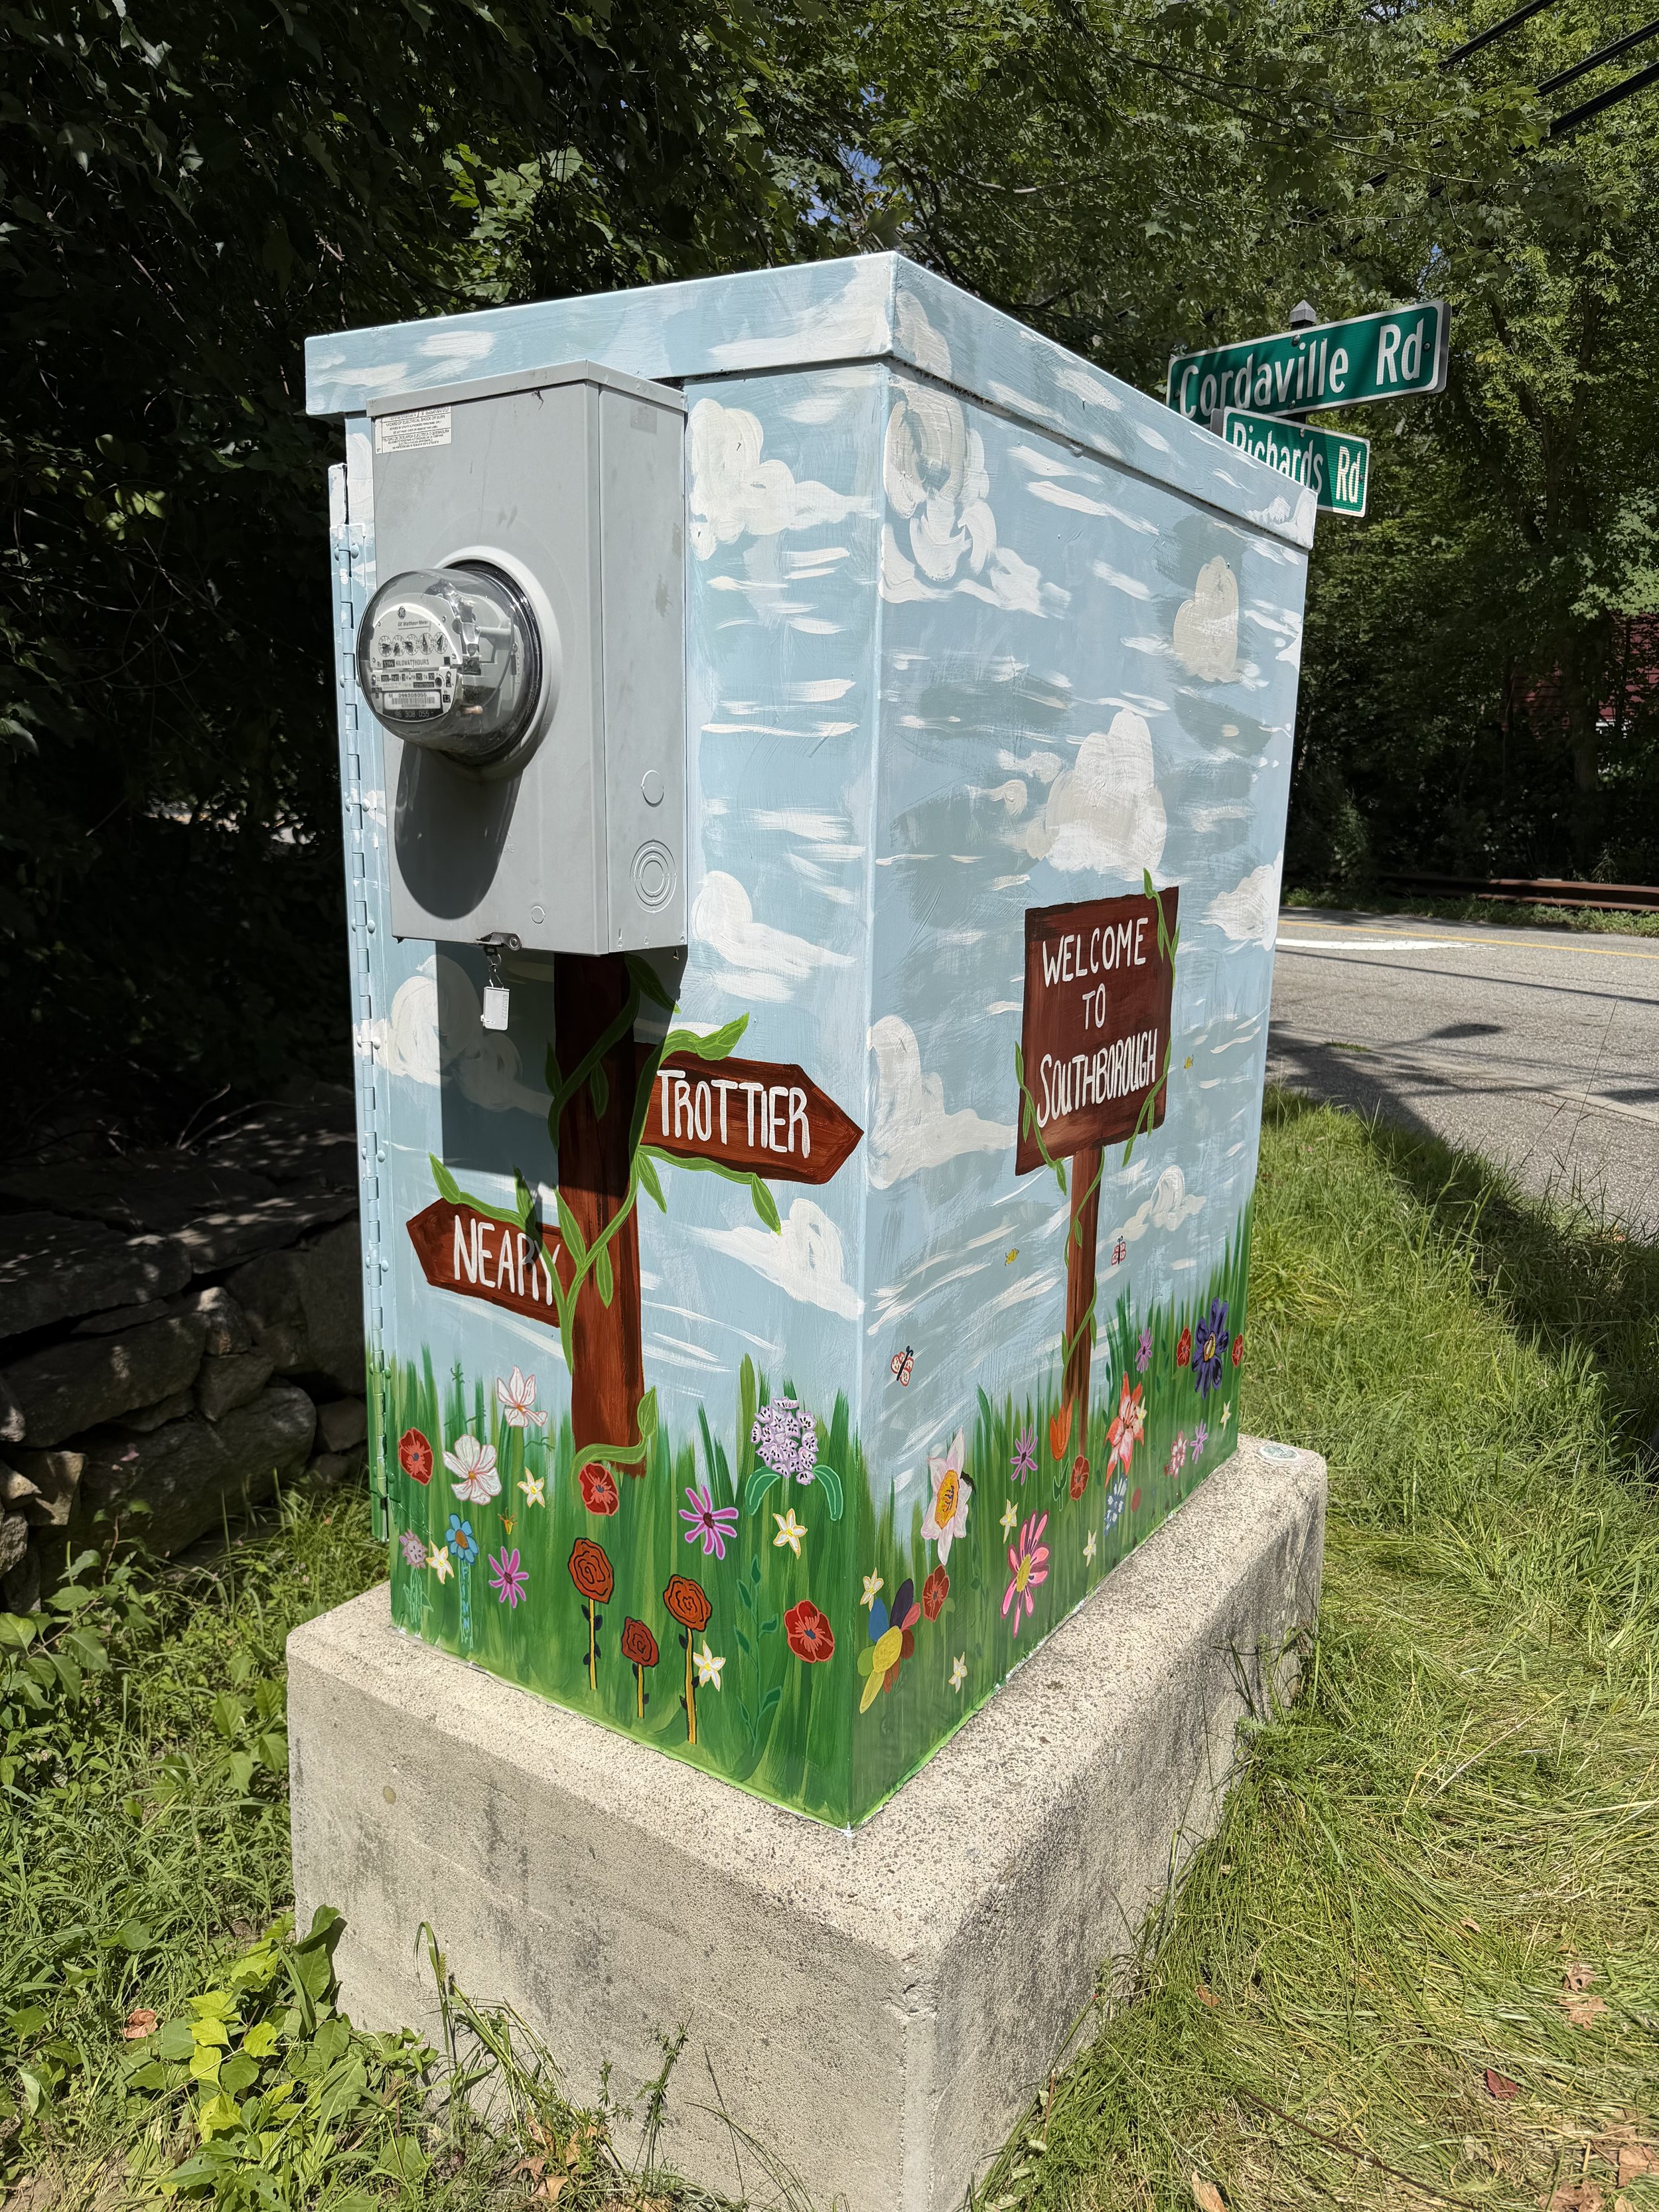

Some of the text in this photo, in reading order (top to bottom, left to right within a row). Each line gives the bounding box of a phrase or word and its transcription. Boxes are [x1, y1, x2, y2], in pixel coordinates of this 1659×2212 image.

[1179, 318, 1424, 419] Cordaville Rd
[1335, 446, 1361, 504] Rd
[1042, 917, 1149, 988] WELCOME
[1082, 983, 1106, 1030] TO
[656, 1069, 811, 1159] TROTTIER
[1036, 1028, 1157, 1128] SOUTHBOROUGH
[453, 1214, 561, 1319] NEARY
